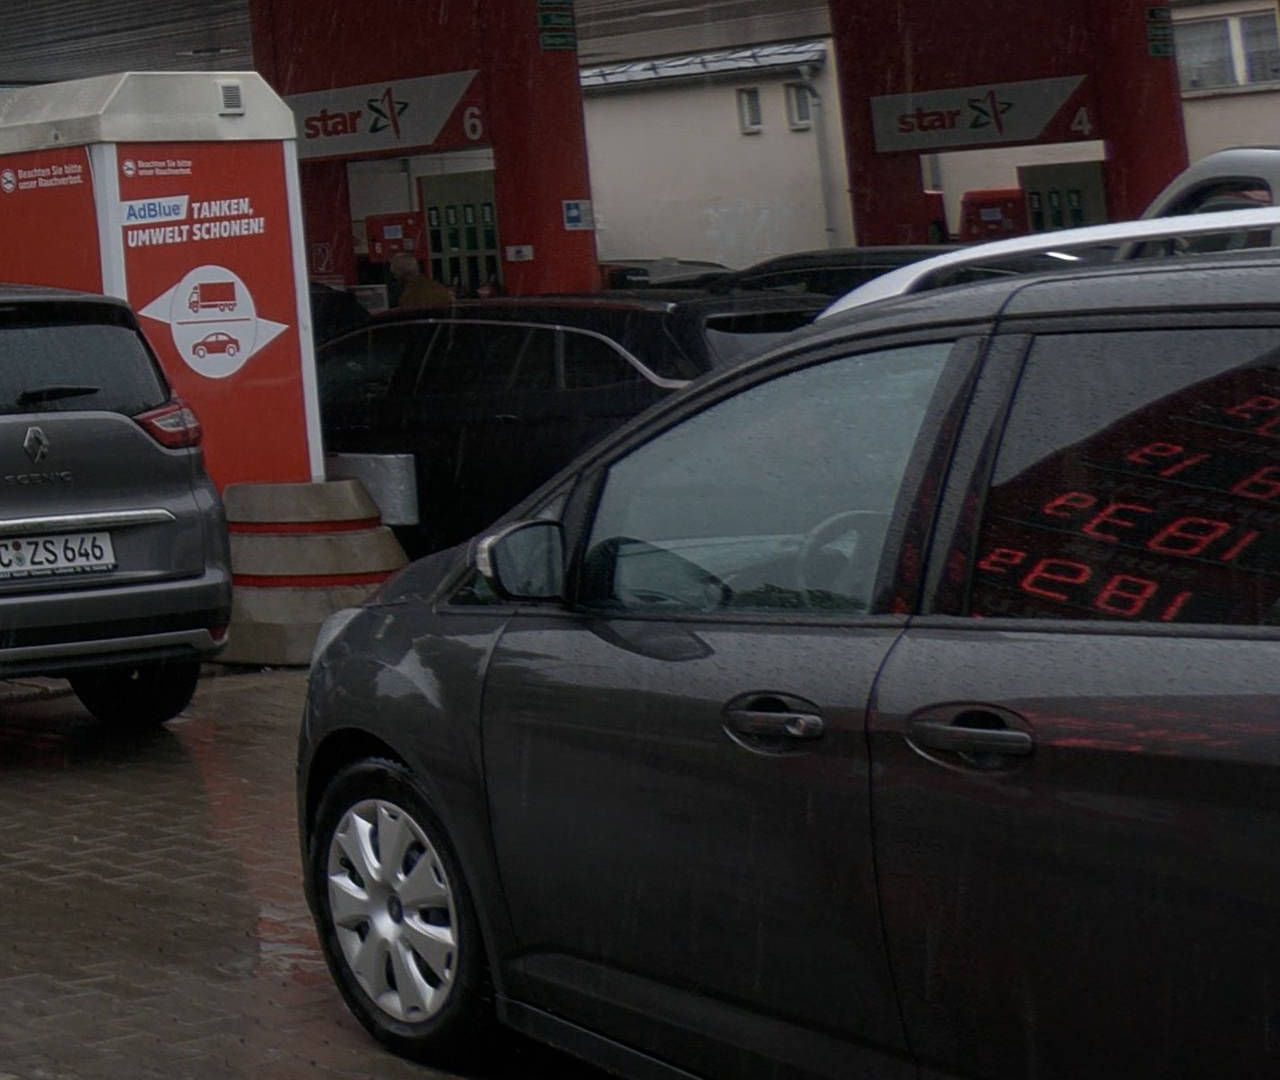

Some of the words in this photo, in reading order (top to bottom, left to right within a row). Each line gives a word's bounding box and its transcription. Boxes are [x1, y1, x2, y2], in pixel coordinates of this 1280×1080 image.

[304, 108, 361, 139] star
[463, 106, 483, 140] 6
[897, 106, 960, 134] star
[1070, 106, 1092, 136] 4
[126, 201, 181, 221] AdBlue
[191, 197, 254, 220] TANKEN,
[127, 224, 190, 248] UMWELT
[192, 217, 265, 241] SCHONEN!
[26, 539, 58, 566] ZS
[62, 535, 104, 563] 646
